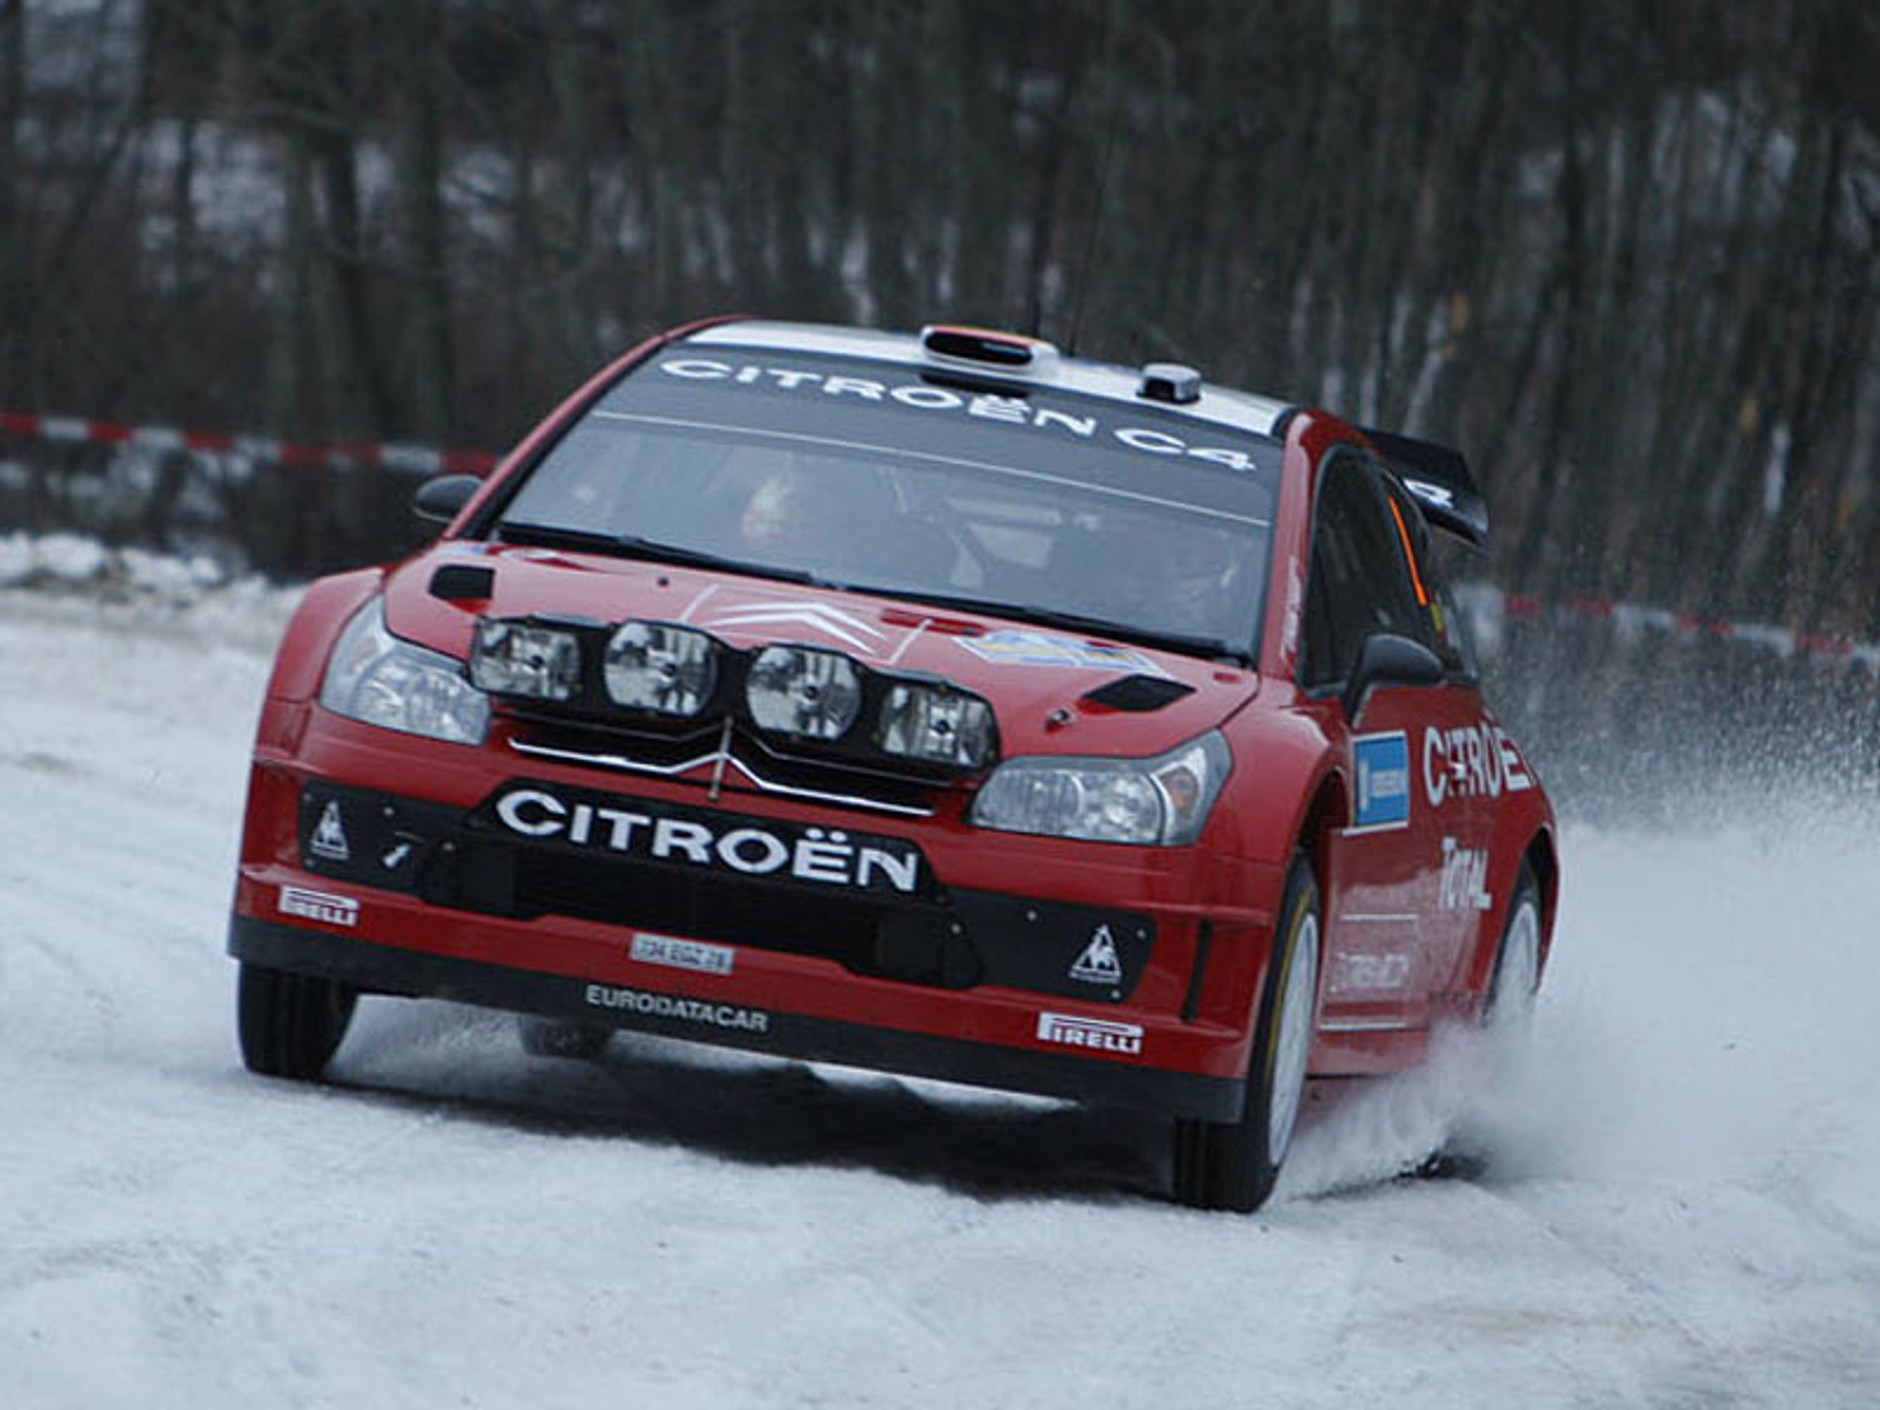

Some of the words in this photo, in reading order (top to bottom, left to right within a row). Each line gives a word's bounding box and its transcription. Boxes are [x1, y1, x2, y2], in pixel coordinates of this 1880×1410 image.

[660, 360, 1098, 437] CITROËN
[1114, 427, 1258, 473] C4
[495, 789, 918, 893] CITROËN
[586, 984, 770, 1034] EURODATACAR
[1036, 1011, 1144, 1054] PIRELLI
